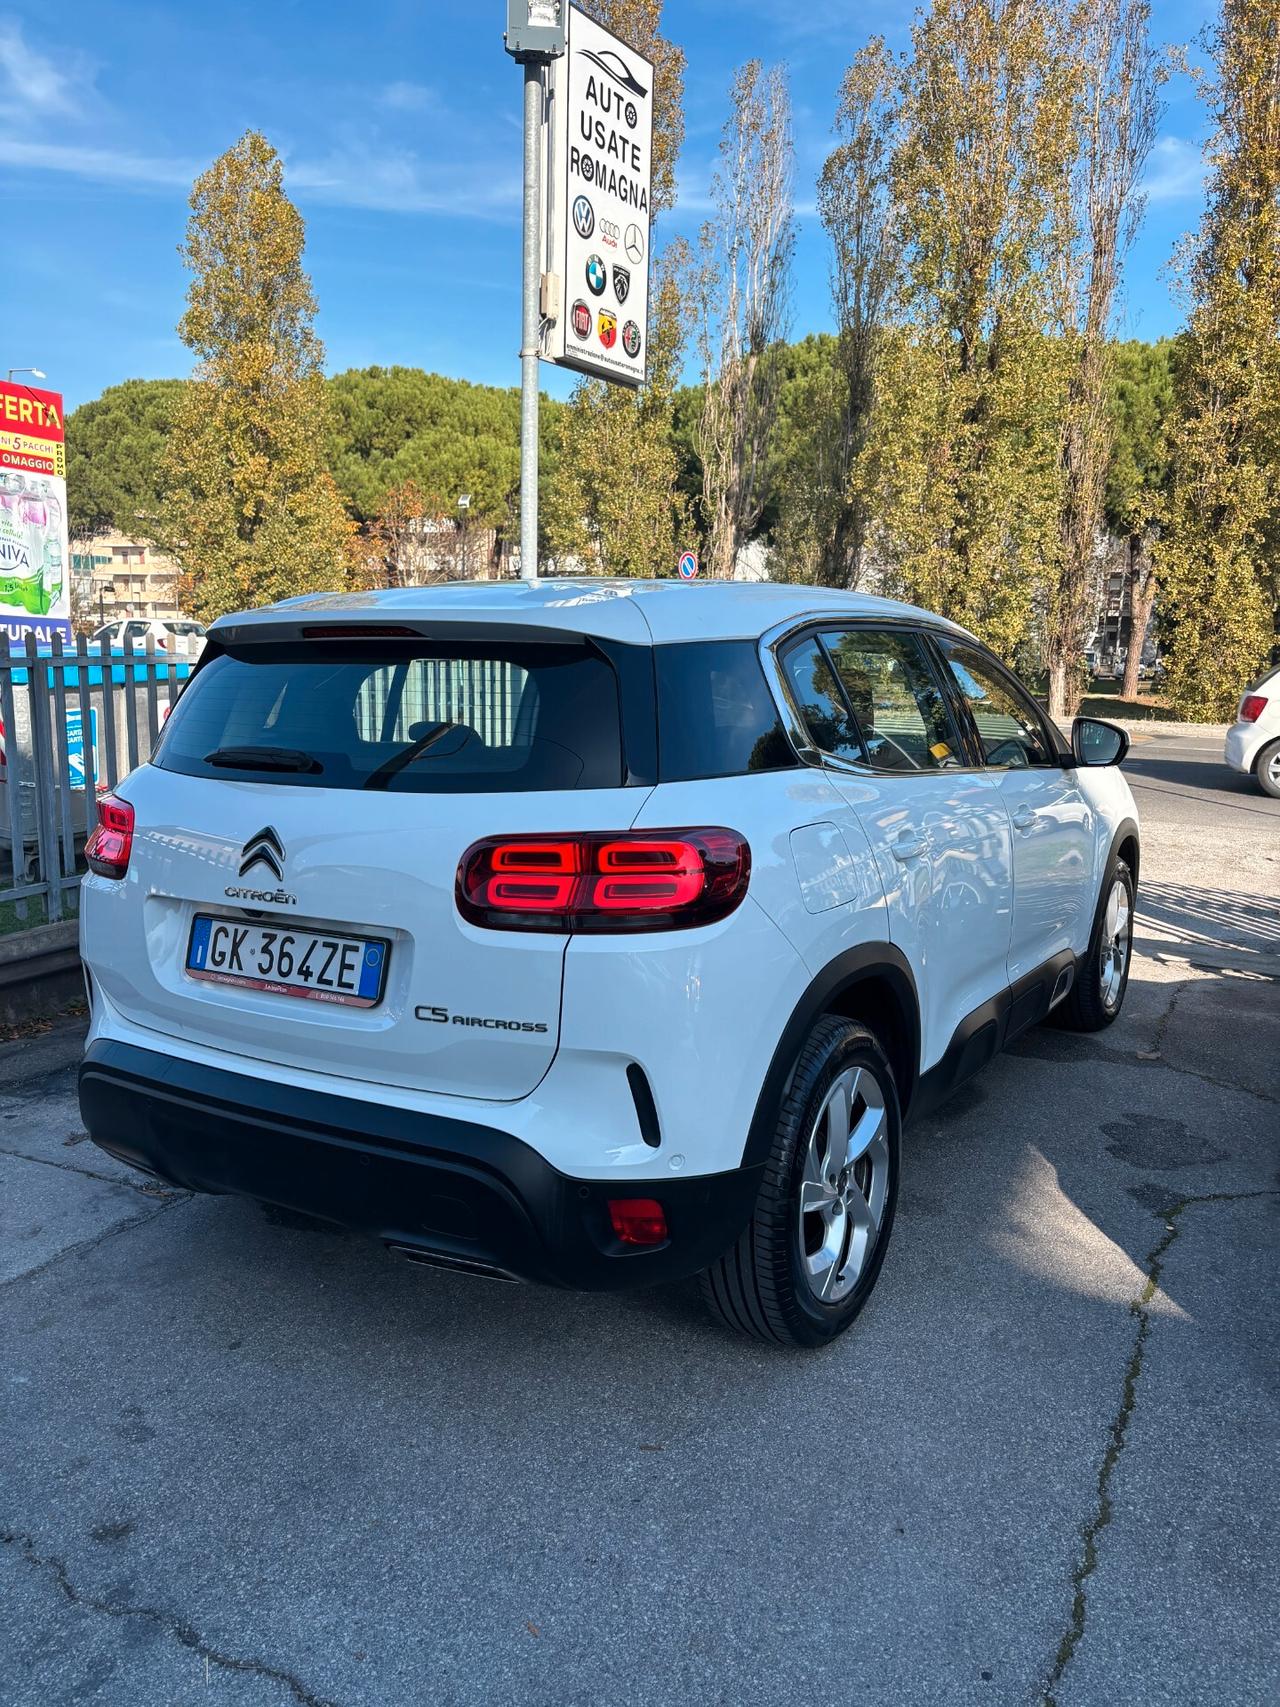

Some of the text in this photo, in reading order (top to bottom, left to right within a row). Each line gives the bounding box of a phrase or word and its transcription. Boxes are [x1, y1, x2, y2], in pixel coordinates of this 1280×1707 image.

[586, 75, 637, 129] AUTO
[581, 110, 641, 173] USATE
[571, 146, 648, 214] ROMAGNA
[0, 393, 61, 430] ERTA
[2, 453, 54, 471] OMAGGIO
[12, 437, 21, 450] 5
[23, 441, 54, 454] PACCHI
[56, 443, 64, 476] PROMO
[224, 886, 297, 905] CITROËN
[211, 926, 249, 971] GK
[257, 932, 360, 990] 364ZE
[414, 1005, 548, 1033] C5 AIRCROSS
